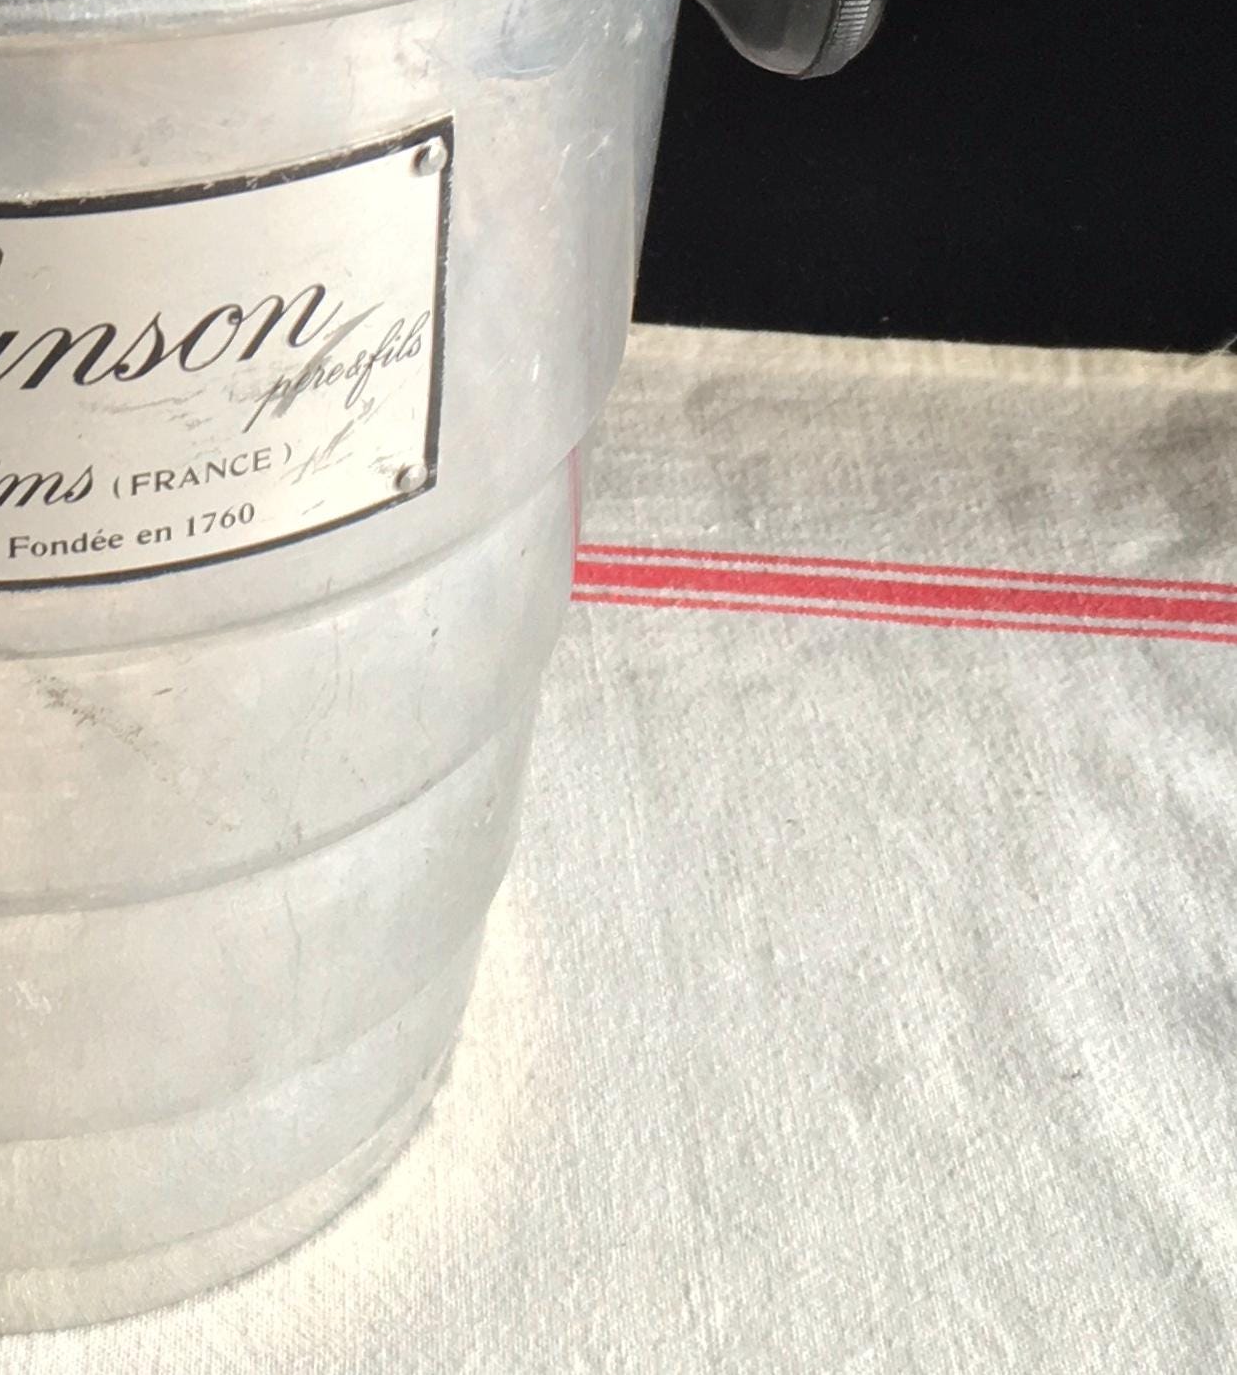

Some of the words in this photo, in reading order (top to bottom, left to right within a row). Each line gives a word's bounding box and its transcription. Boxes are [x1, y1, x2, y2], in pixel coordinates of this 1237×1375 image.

[8, 528, 125, 559] Fondée
[136, 526, 173, 546] en
[185, 501, 258, 539] 1760
